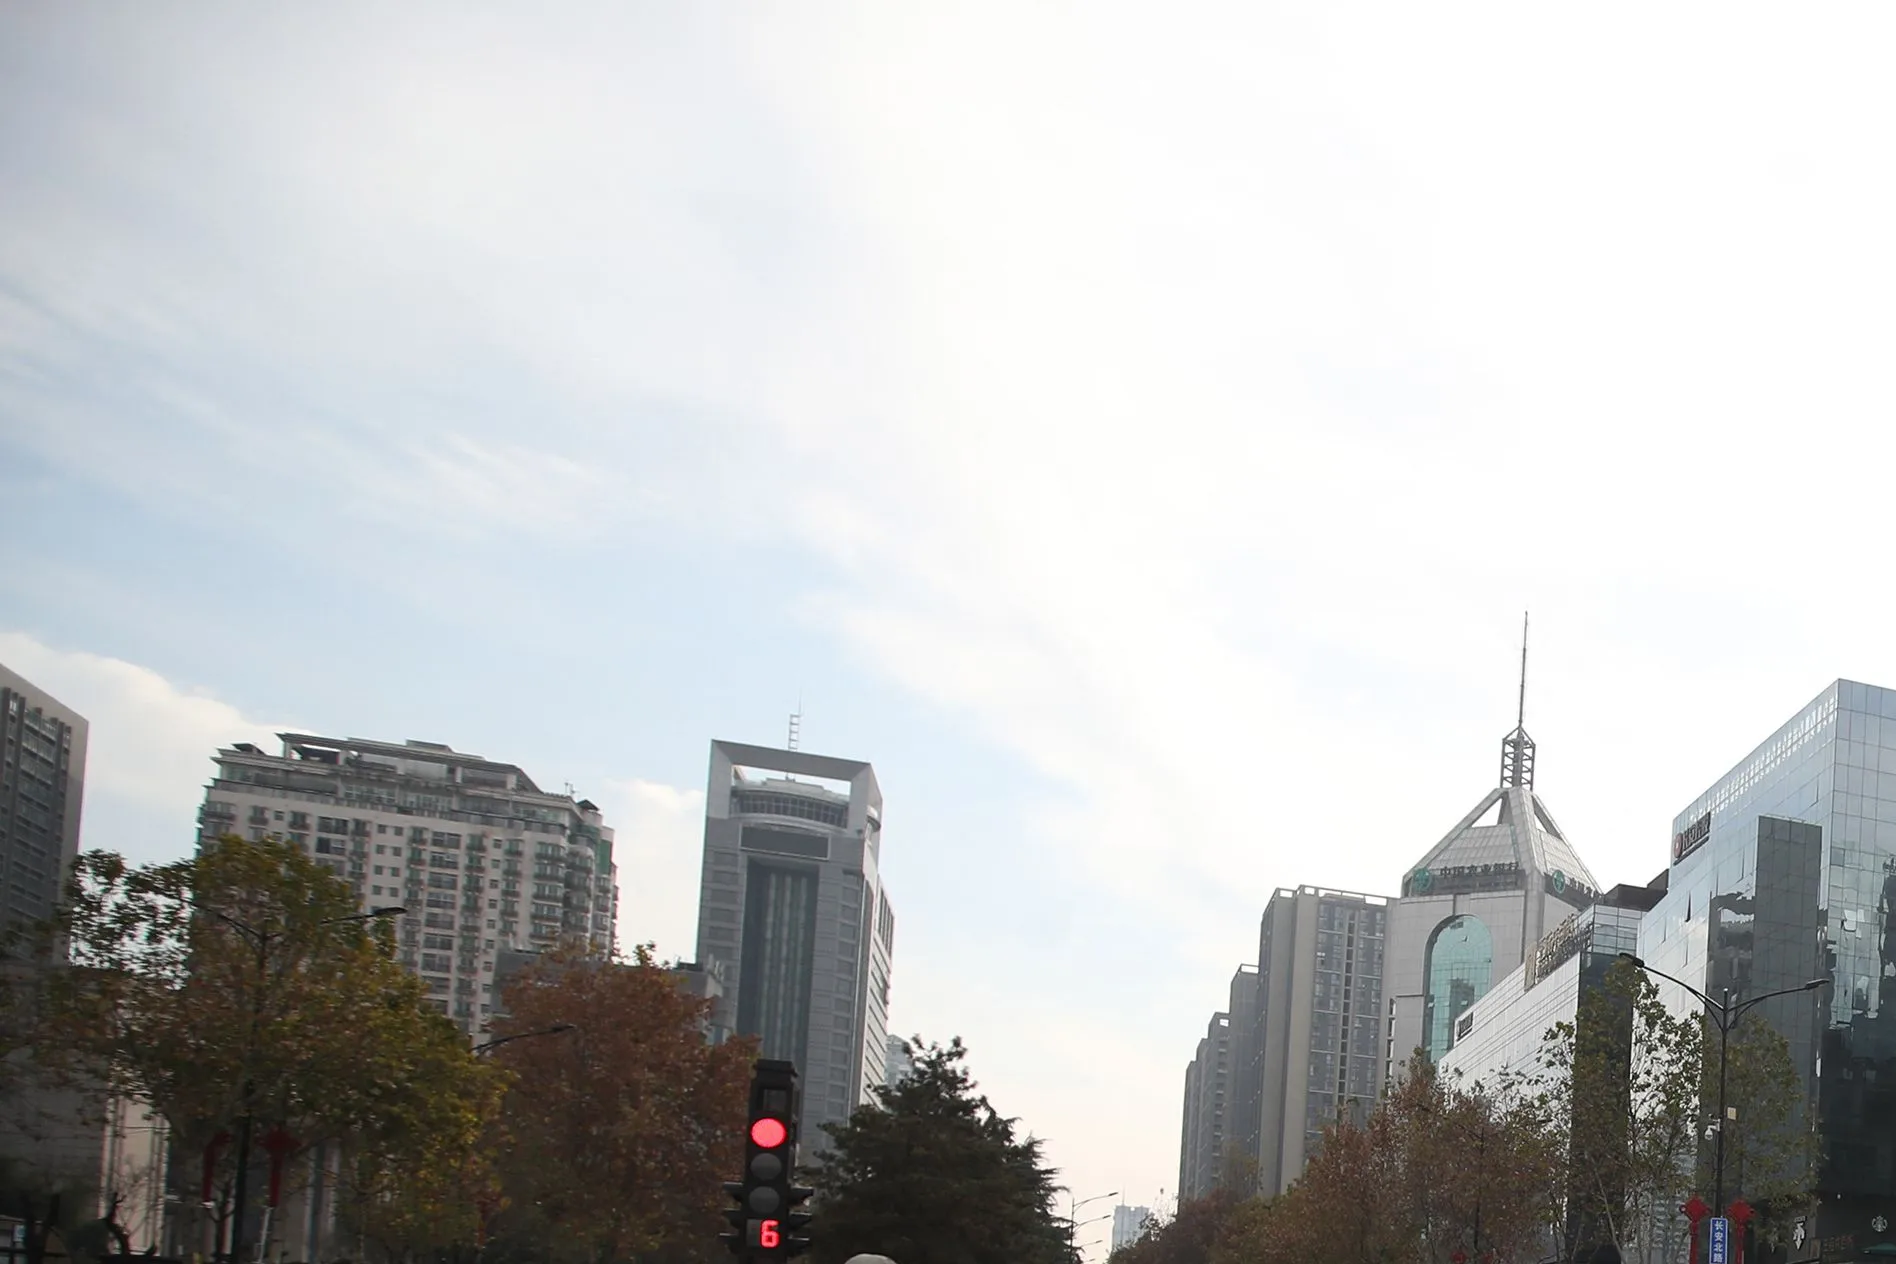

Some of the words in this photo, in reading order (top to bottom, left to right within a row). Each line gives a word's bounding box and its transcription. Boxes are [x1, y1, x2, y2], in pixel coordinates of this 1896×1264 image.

[760, 1218, 781, 1249] 6
[1712, 1220, 1724, 1263] 长安北路
